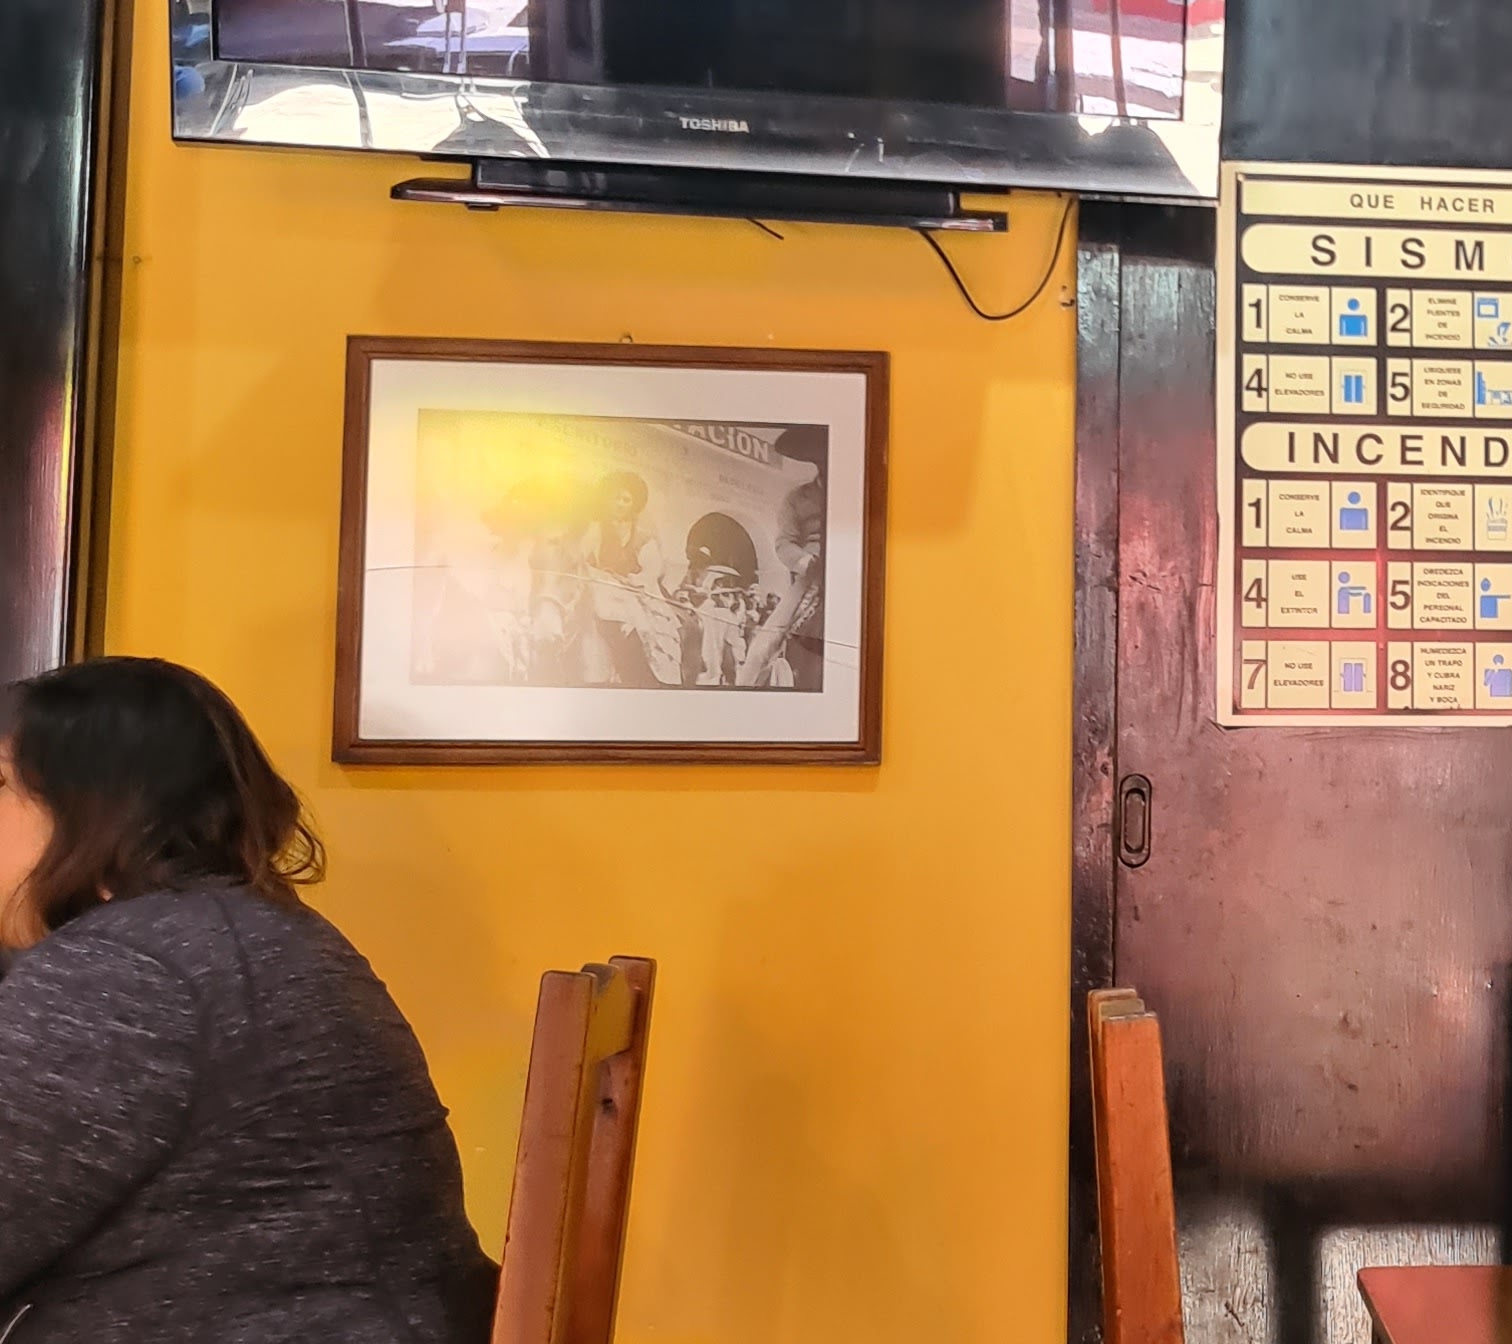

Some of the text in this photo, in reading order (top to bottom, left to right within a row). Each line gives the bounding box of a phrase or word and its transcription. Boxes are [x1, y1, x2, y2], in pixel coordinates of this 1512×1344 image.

[679, 116, 750, 133] TOSHIBA
[1350, 192, 1396, 210] QUE
[1420, 196, 1496, 215] HACER
[1248, 298, 1263, 329] 1
[1389, 302, 1411, 332] 2
[1244, 367, 1268, 399] 4
[1389, 372, 1411, 402] 5
[1247, 497, 1262, 529] 1
[1389, 500, 1411, 532] 2
[1243, 577, 1267, 609] 4
[1389, 579, 1411, 611] 5
[1243, 658, 1268, 690] 7
[1389, 659, 1411, 692] 8
